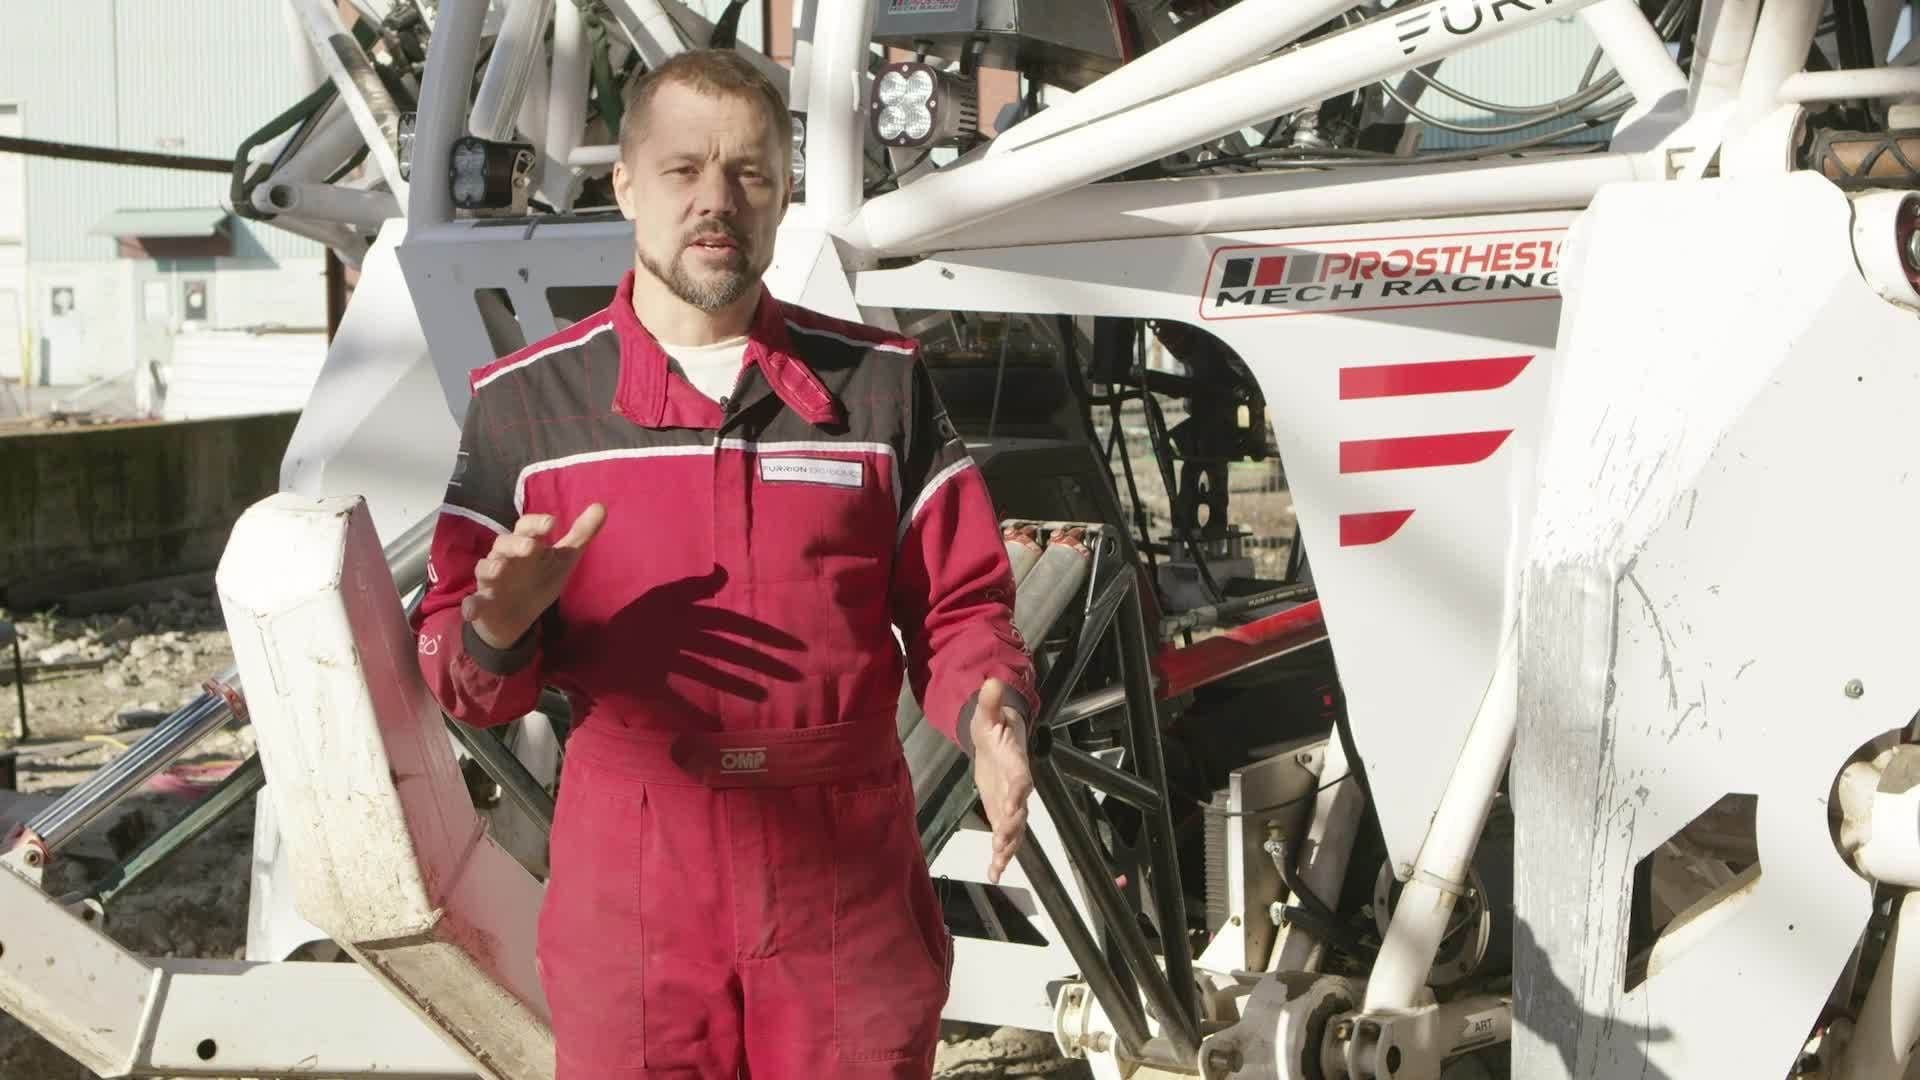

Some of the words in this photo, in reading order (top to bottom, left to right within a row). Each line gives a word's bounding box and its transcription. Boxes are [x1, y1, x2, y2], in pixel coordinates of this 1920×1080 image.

[1318, 240, 1563, 283] PROSTHESI
[1215, 281, 1364, 307] MECH
[721, 751, 766, 769] OMP
[1474, 1018, 1494, 1033] ART
